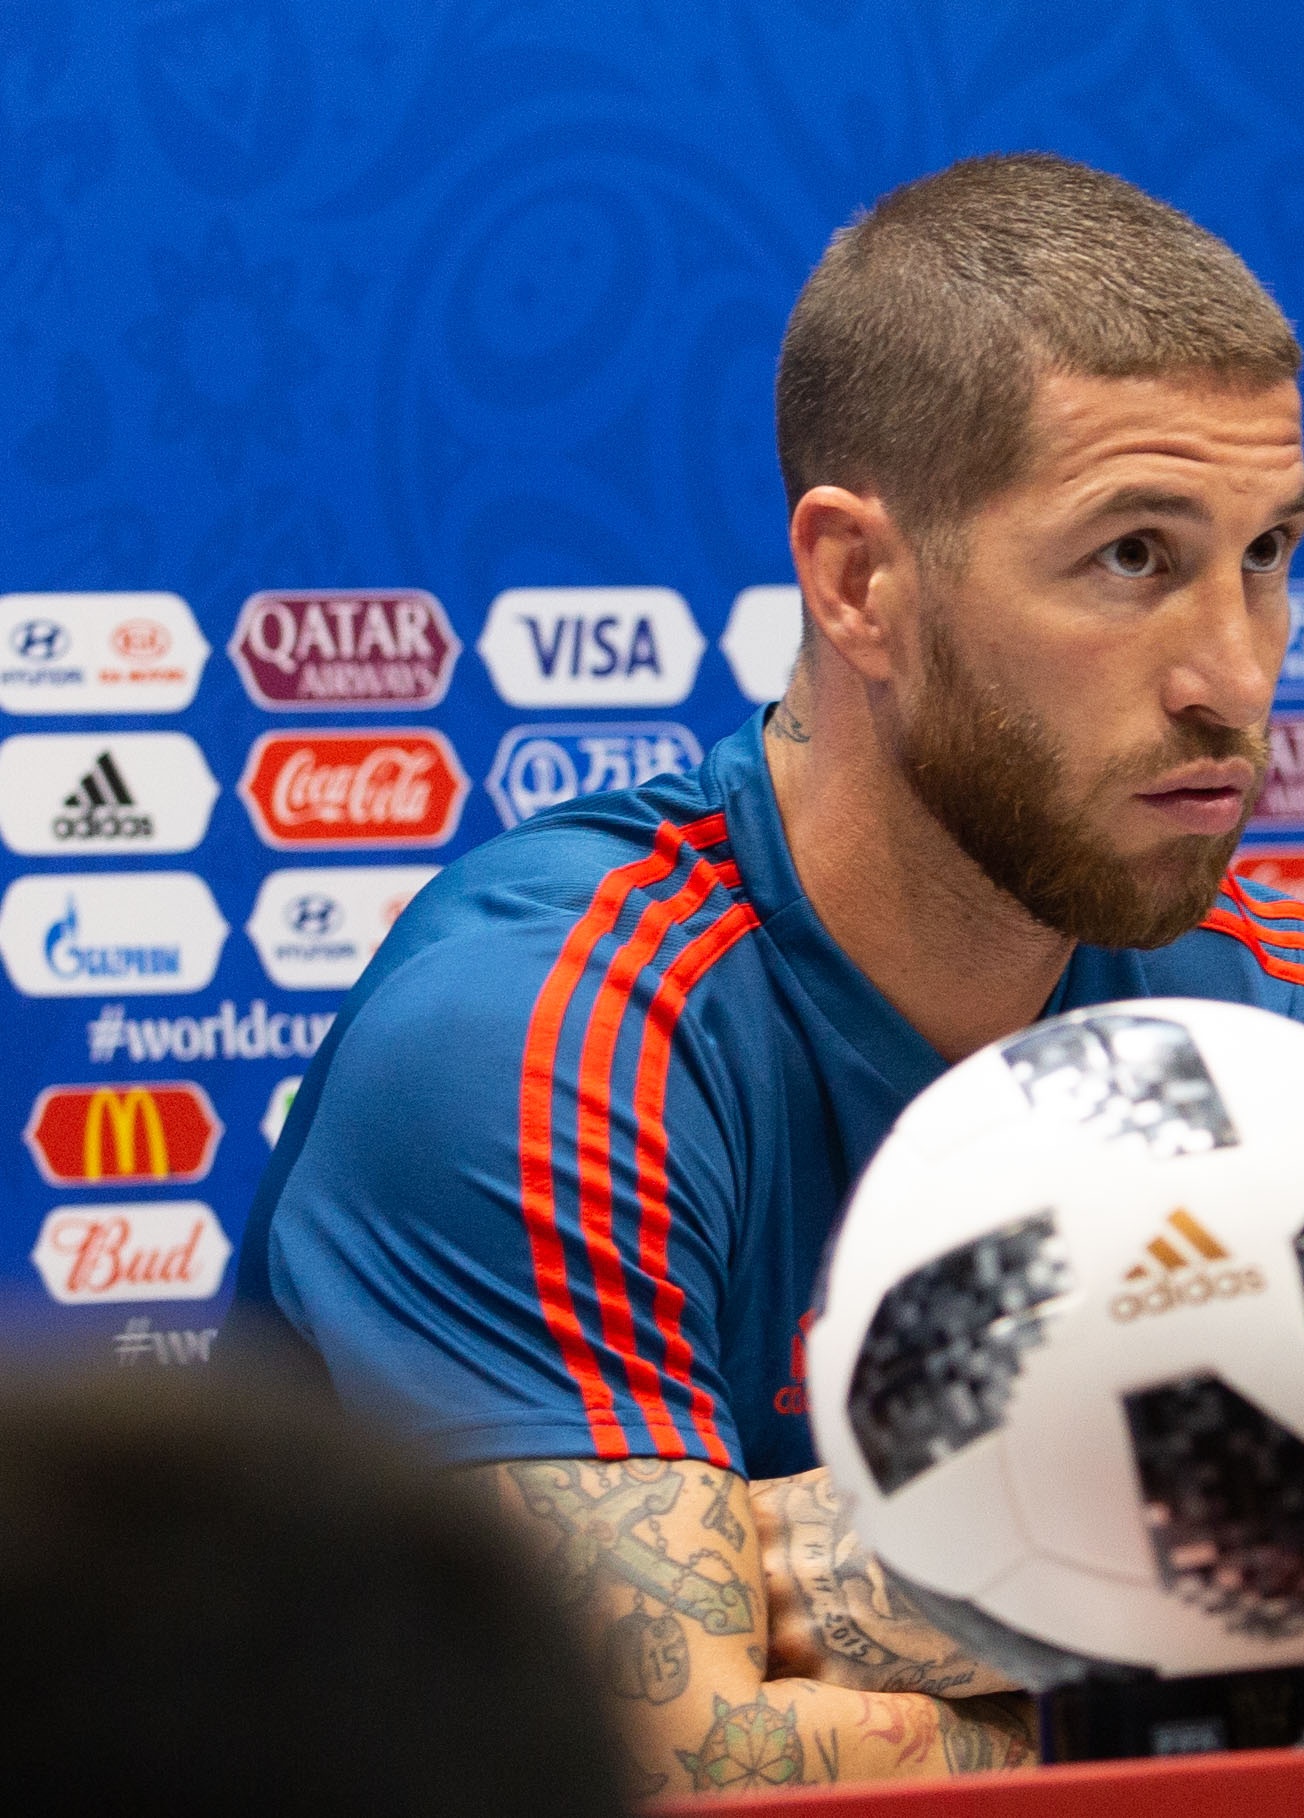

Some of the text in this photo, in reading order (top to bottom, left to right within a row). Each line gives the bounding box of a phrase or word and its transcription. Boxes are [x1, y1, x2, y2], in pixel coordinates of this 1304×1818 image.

[248, 602, 434, 674] QATAR
[517, 616, 664, 680] VISA
[270, 744, 438, 828] Coca-Cola
[51, 810, 153, 842] adidas
[86, 1000, 338, 1063] #worldcu
[52, 1214, 206, 1296] Bud
[1108, 1264, 1268, 1324] adidas
[648, 1644, 683, 1682] 15
